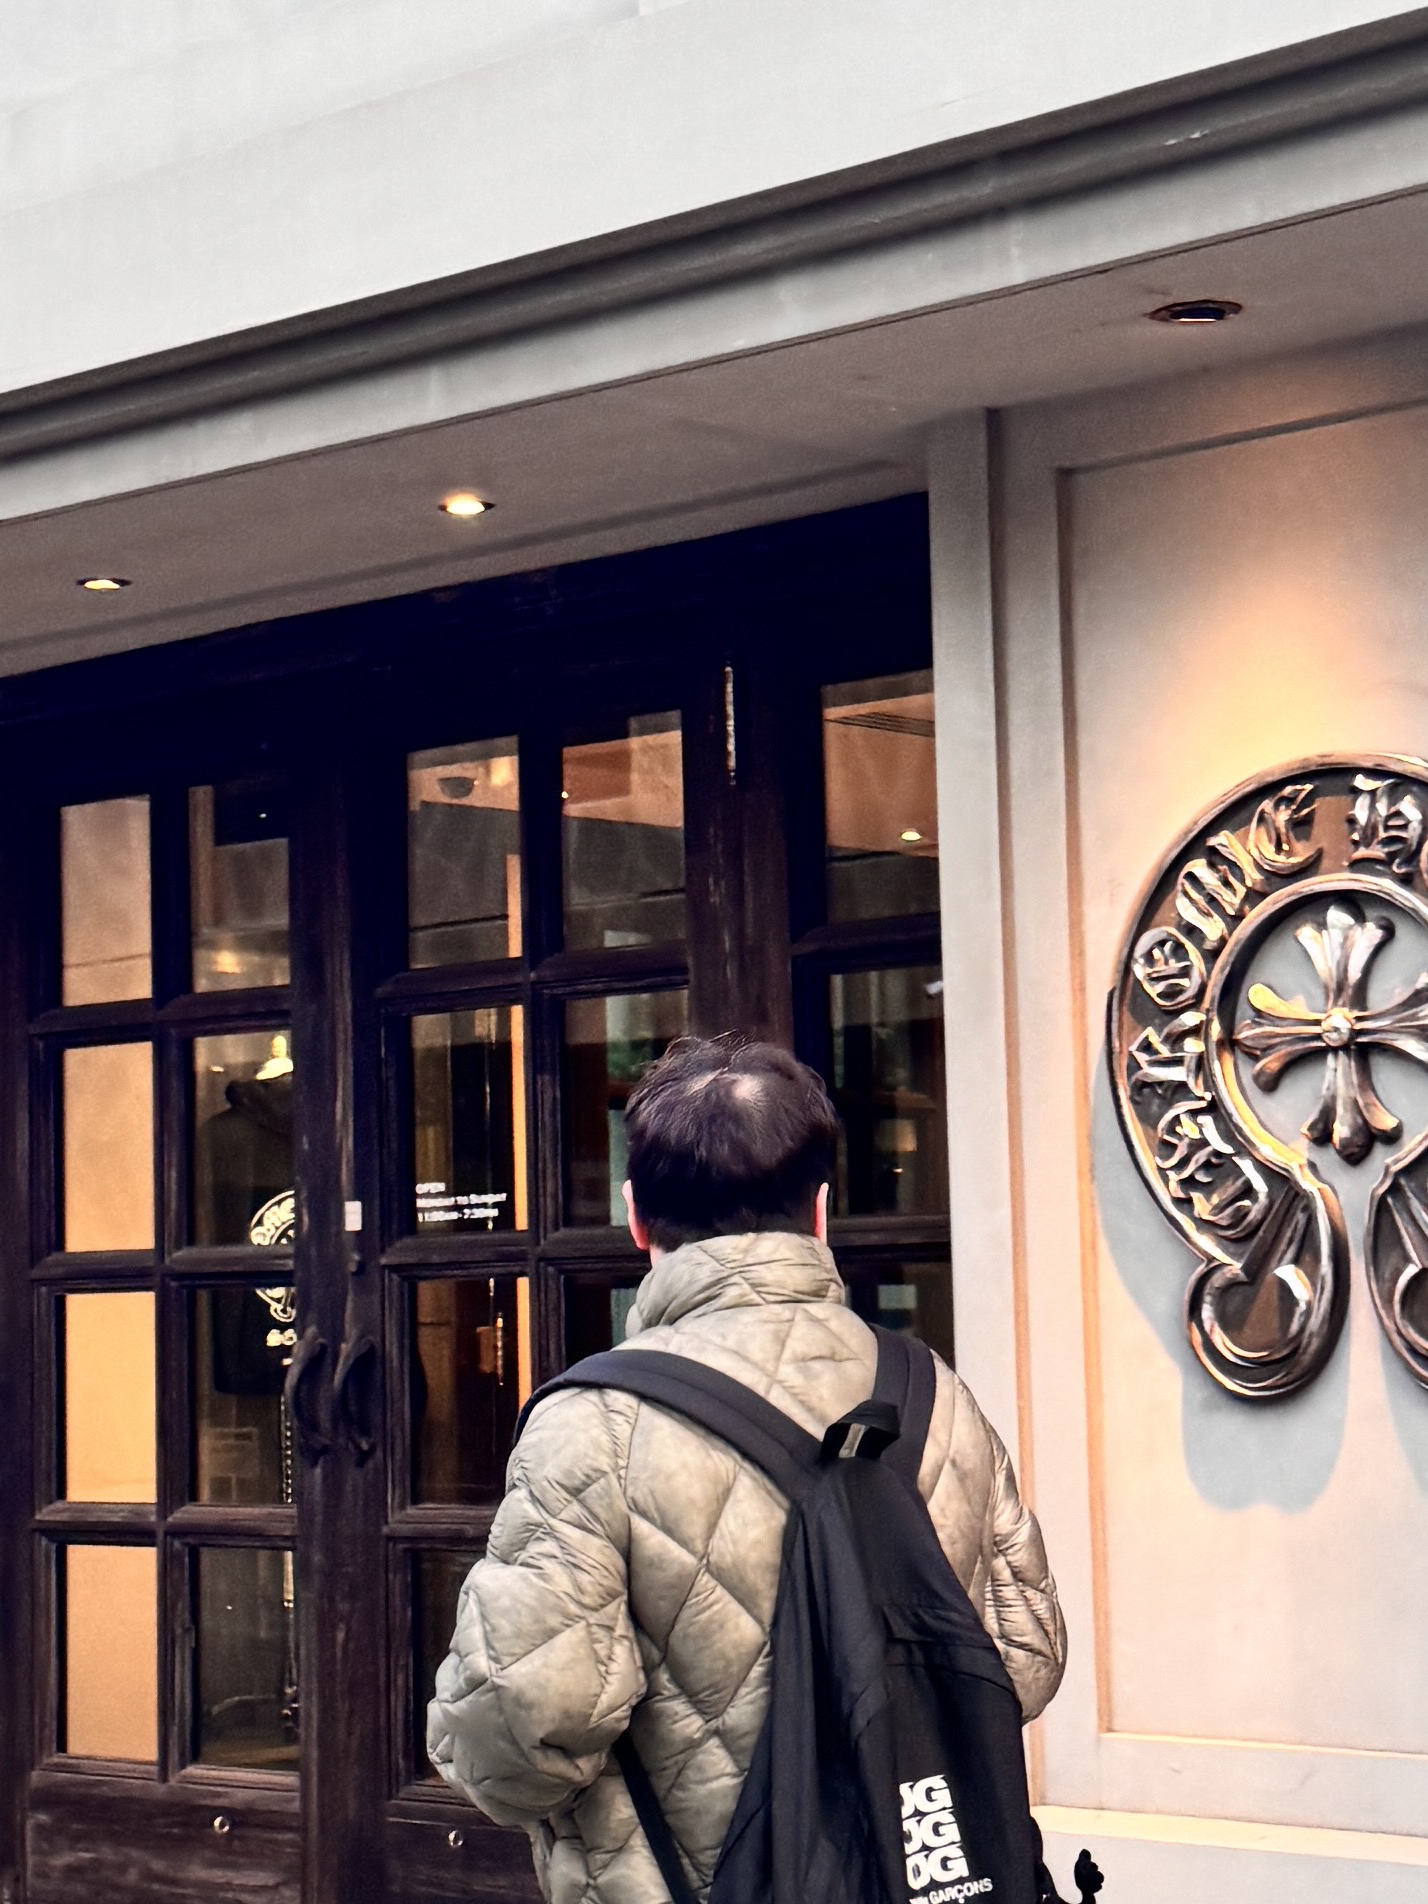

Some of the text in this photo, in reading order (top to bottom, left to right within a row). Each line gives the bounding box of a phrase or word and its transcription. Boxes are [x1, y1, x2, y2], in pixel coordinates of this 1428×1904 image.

[1130, 782, 1325, 1239] CHROME
[415, 1182, 446, 1194] OPEN
[929, 1878, 993, 1904] GARÇONS
